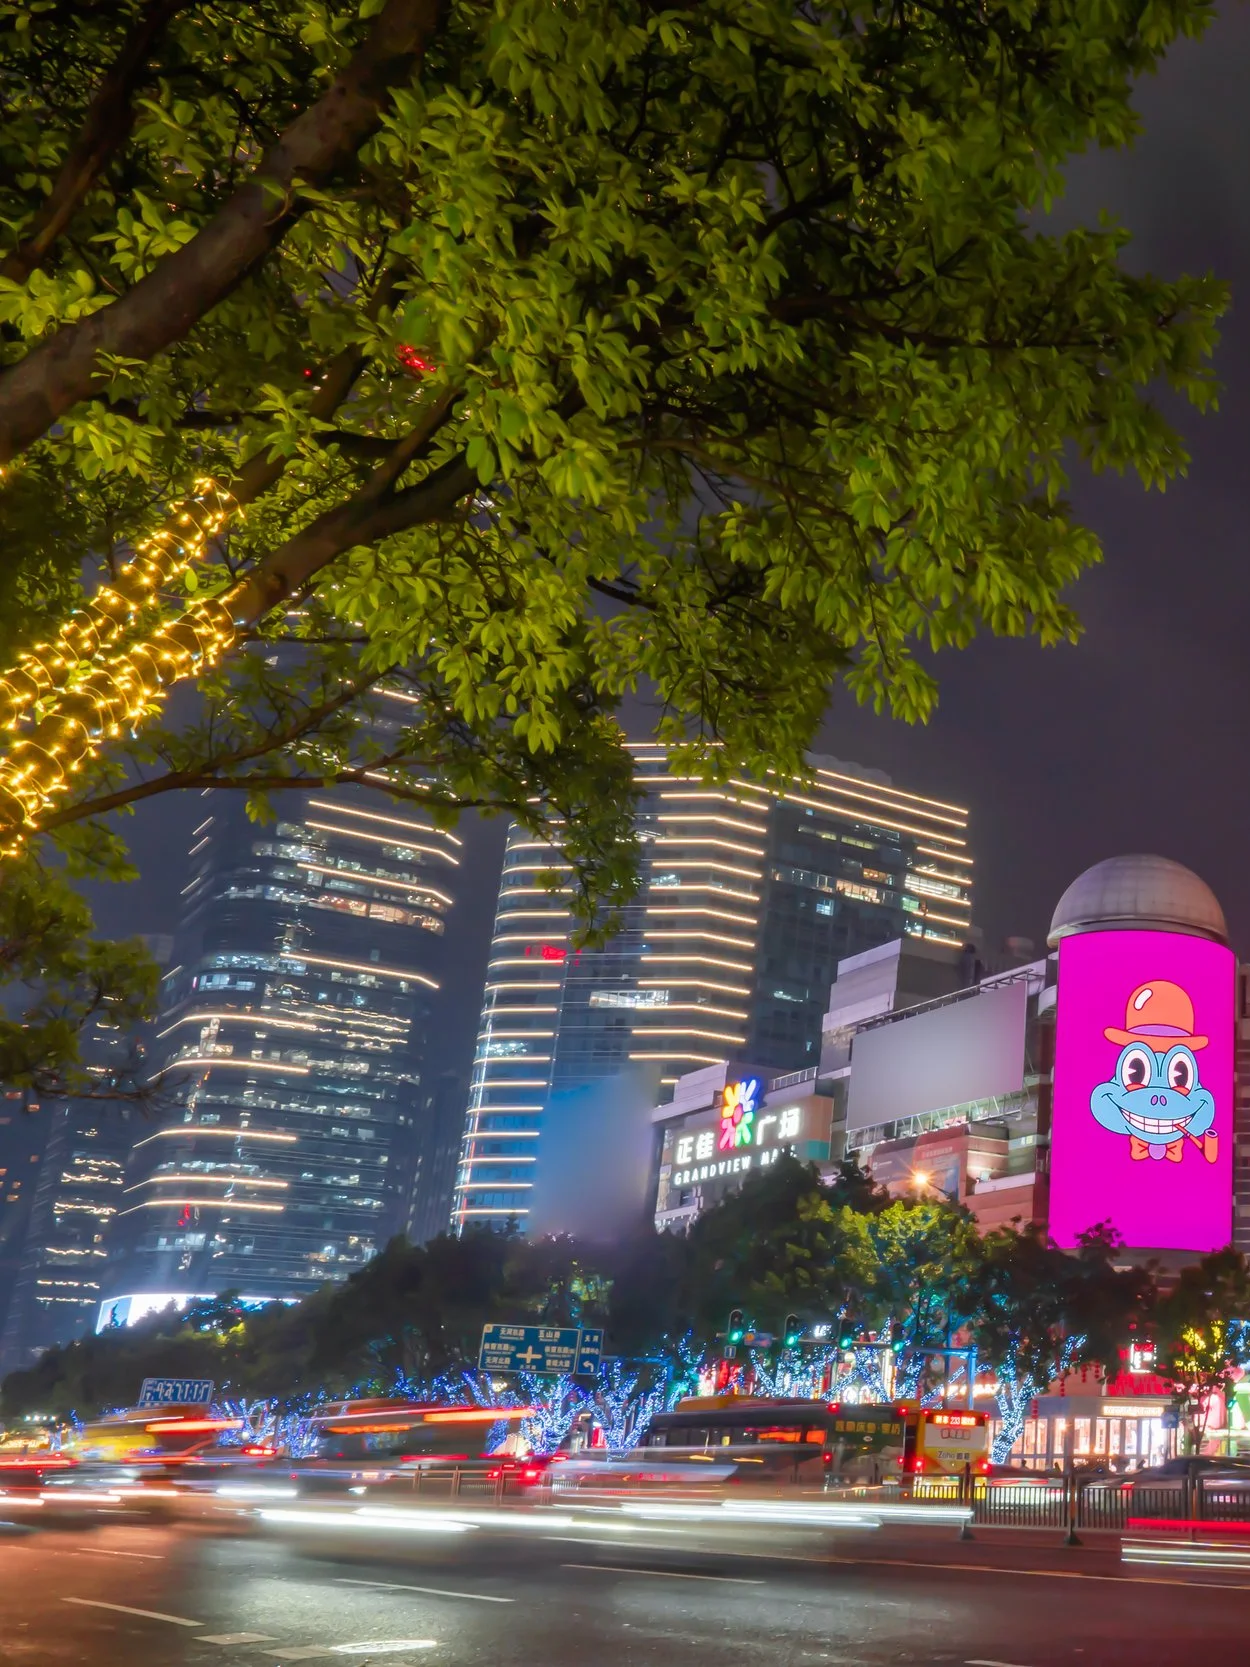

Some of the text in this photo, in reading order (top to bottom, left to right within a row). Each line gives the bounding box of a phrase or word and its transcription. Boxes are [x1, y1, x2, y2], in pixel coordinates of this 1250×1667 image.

[676, 1107, 801, 1165] 正佳 广场
[673, 1144, 798, 1187] GRANDVIEW MA
[950, 1416, 961, 1425] 233
